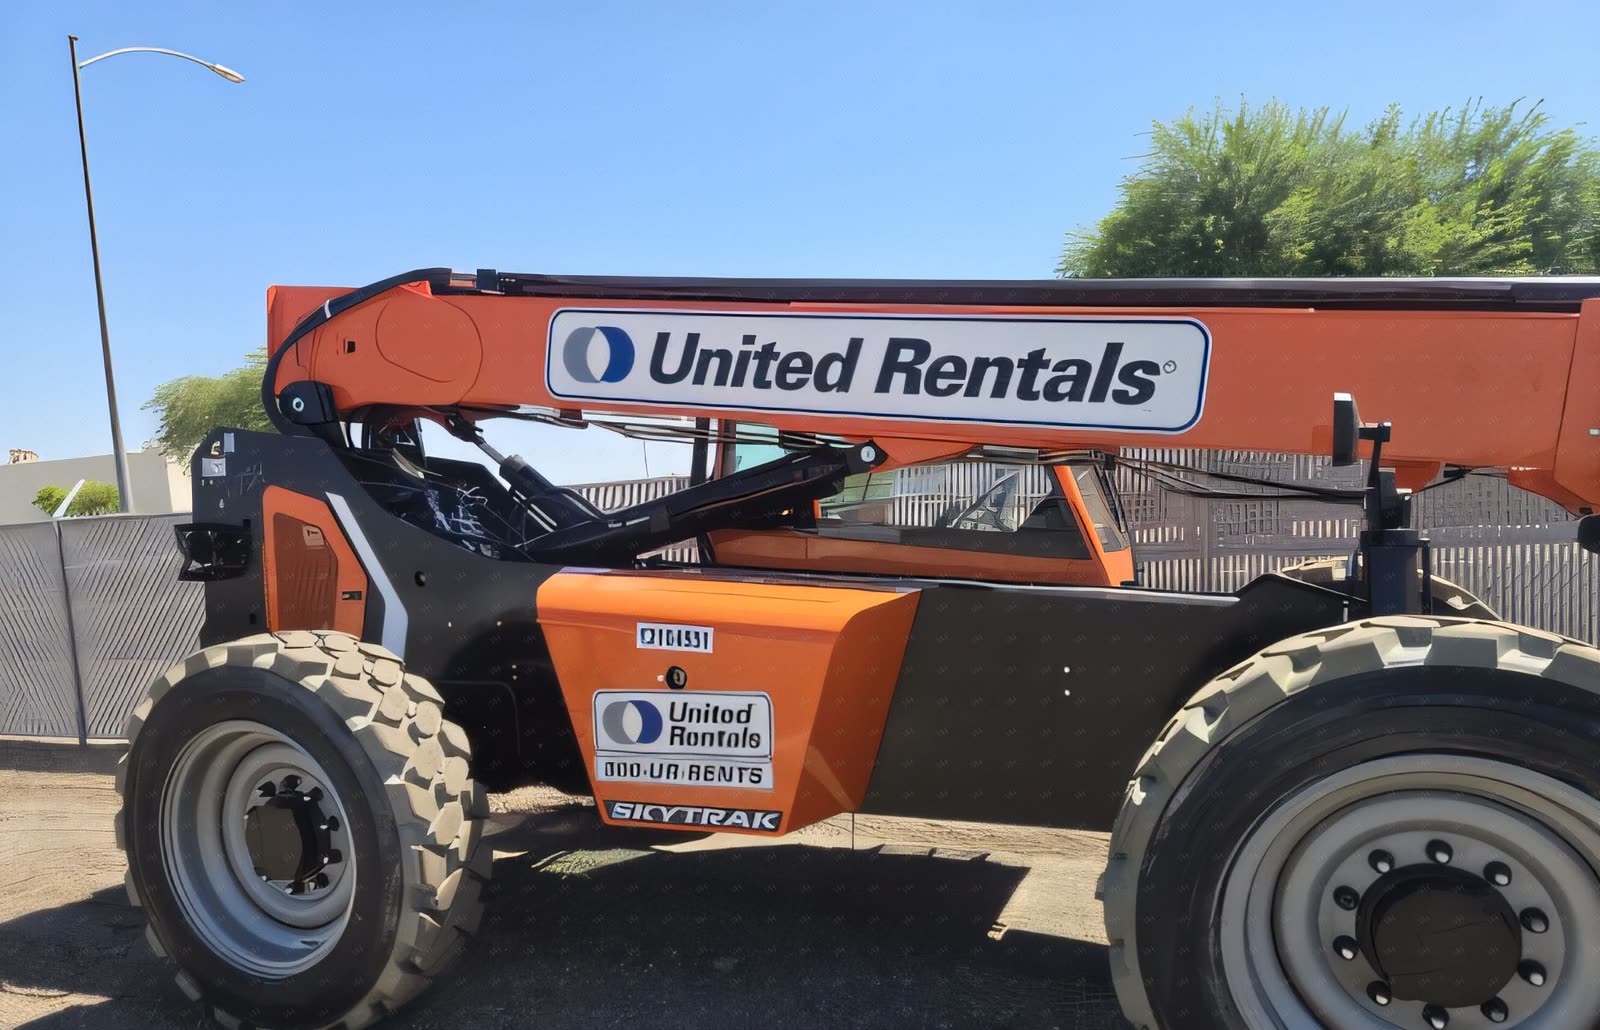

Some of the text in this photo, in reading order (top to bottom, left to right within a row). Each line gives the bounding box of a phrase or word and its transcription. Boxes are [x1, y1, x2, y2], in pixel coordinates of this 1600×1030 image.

[650, 332, 1161, 405] United Rentals
[611, 802, 781, 829] SKYTRAK
